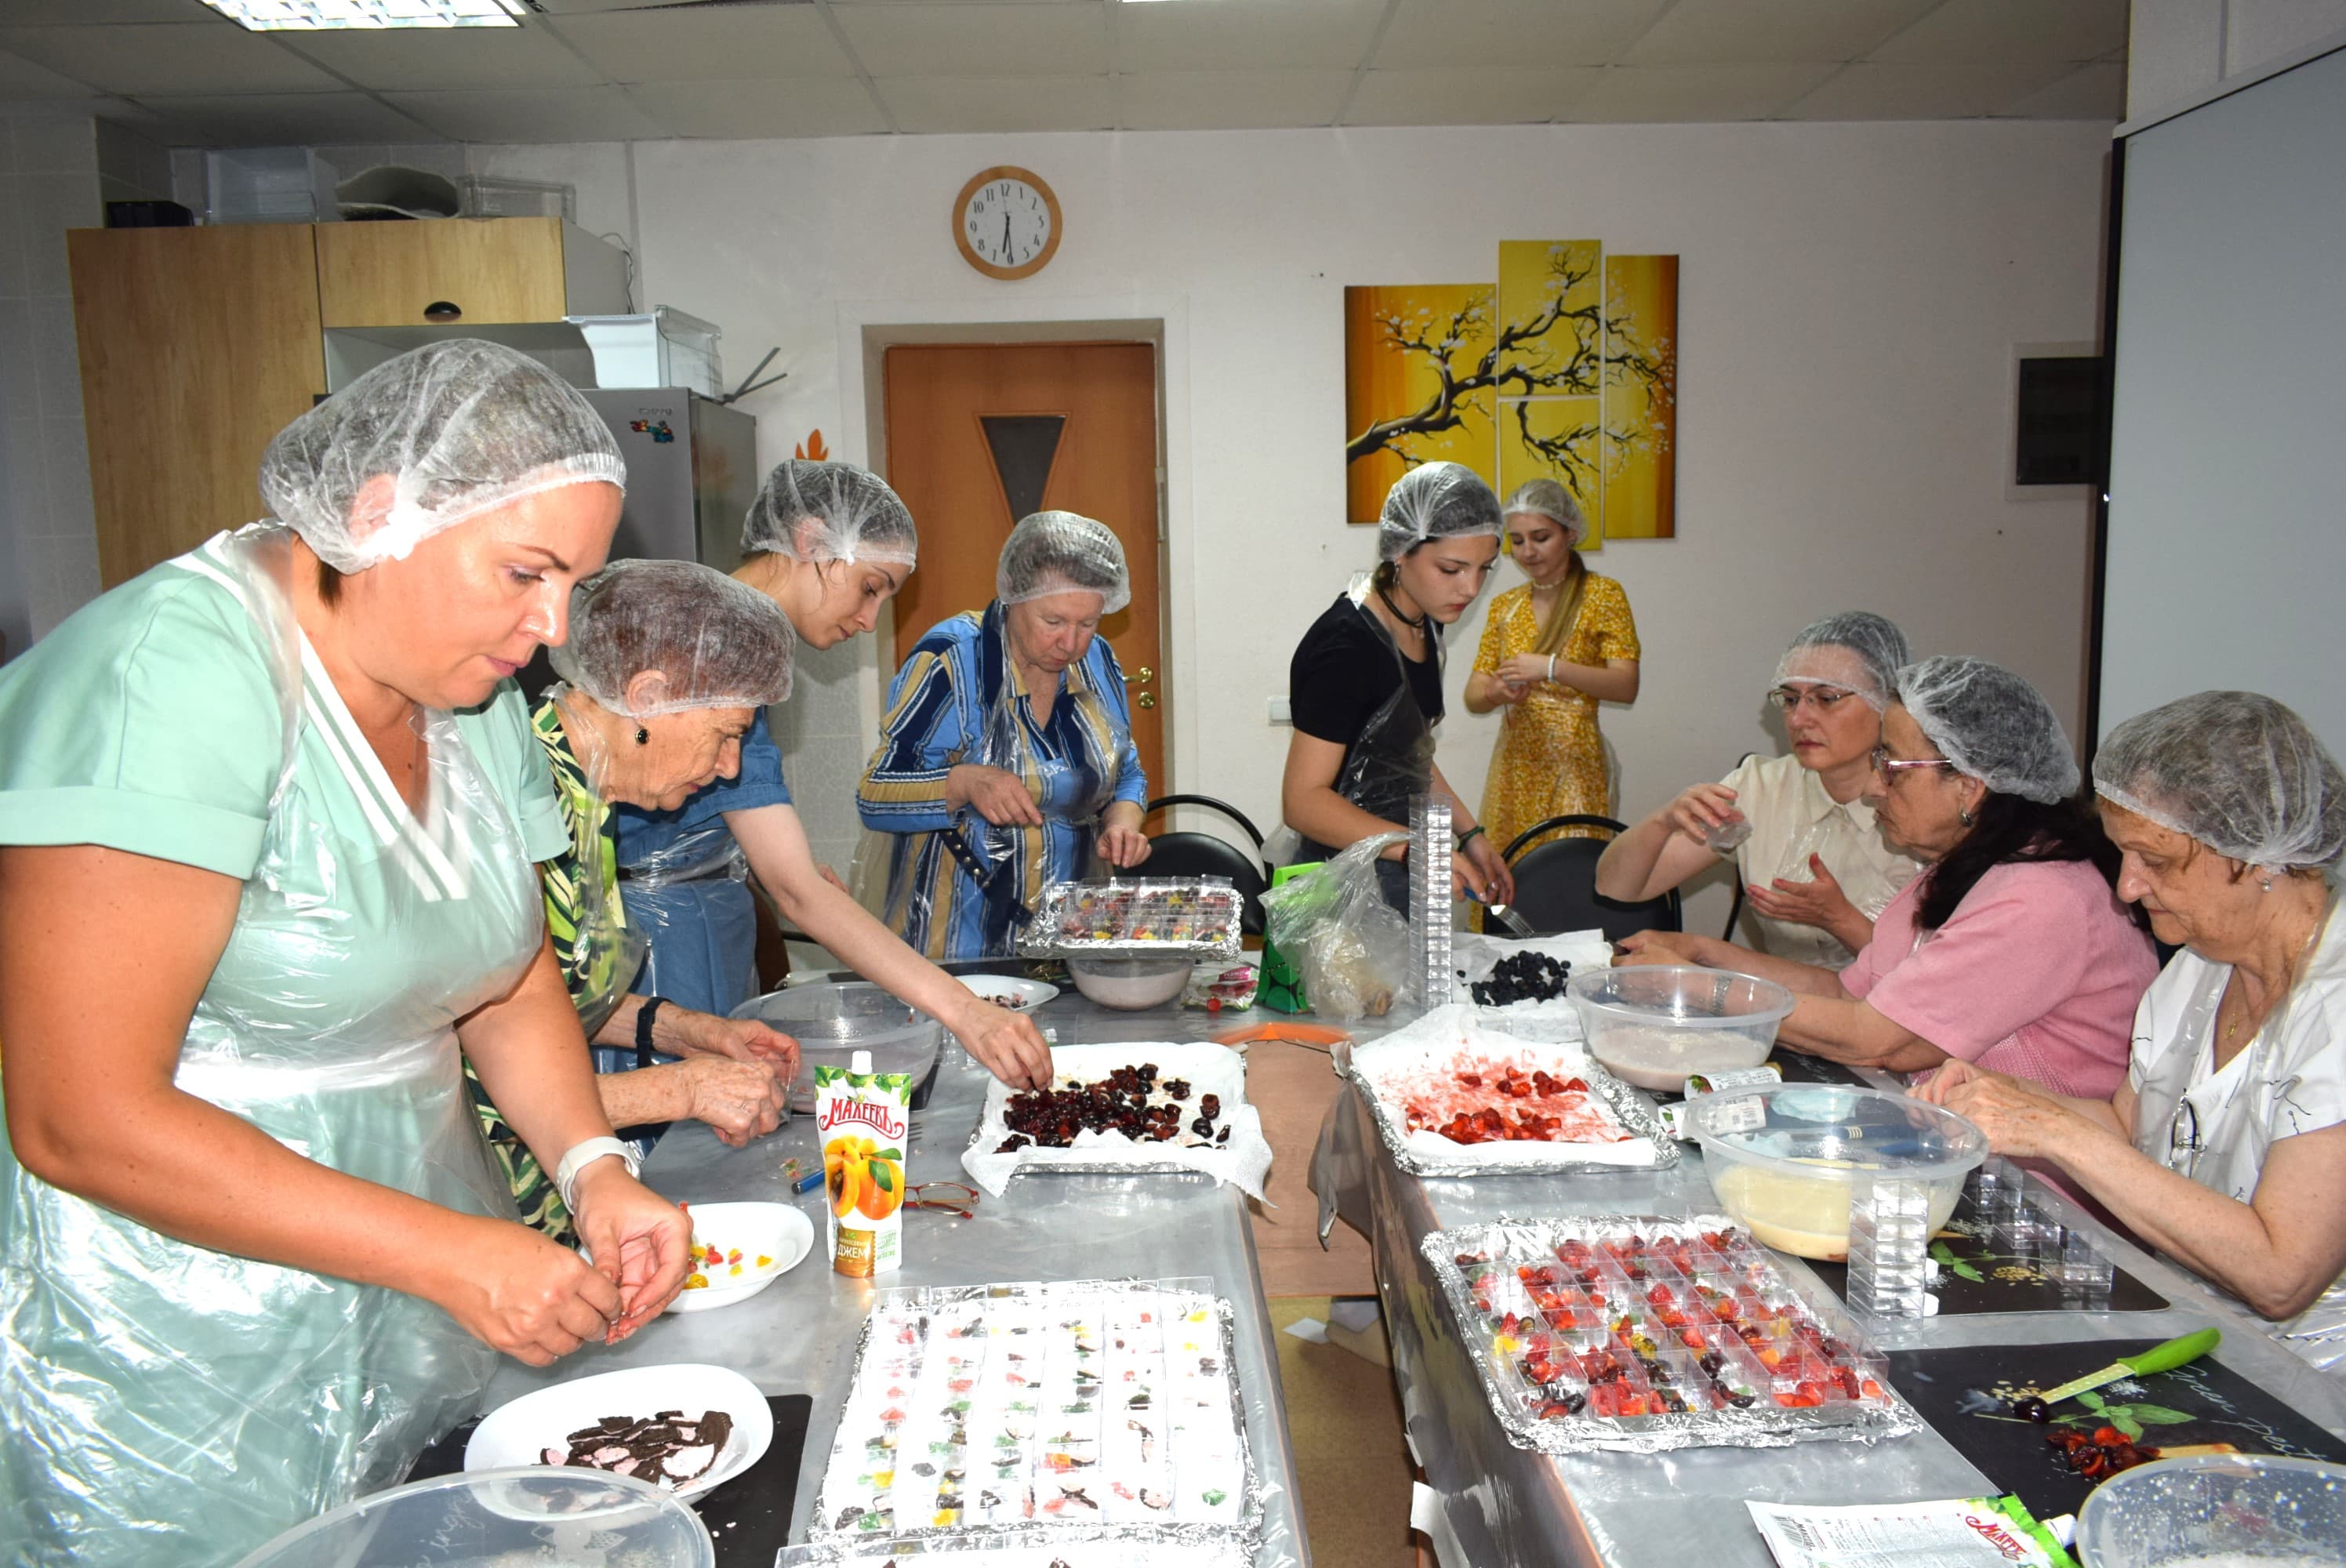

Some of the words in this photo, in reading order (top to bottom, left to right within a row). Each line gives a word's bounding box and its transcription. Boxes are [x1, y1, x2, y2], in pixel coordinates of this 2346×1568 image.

[986, 188, 994, 201] 11
[1000, 183, 1011, 197] 12
[973, 201, 984, 213] 10
[1031, 197, 1037, 210] 2
[970, 220, 978, 233] 9
[1038, 215, 1044, 228] 3
[978, 238, 985, 251] 8
[1033, 234, 1040, 246] 4
[1023, 247, 1030, 259] 5
[819, 1098, 905, 1140] МАХЕЕВЪ
[837, 1243, 867, 1258] ДЖЕМ
